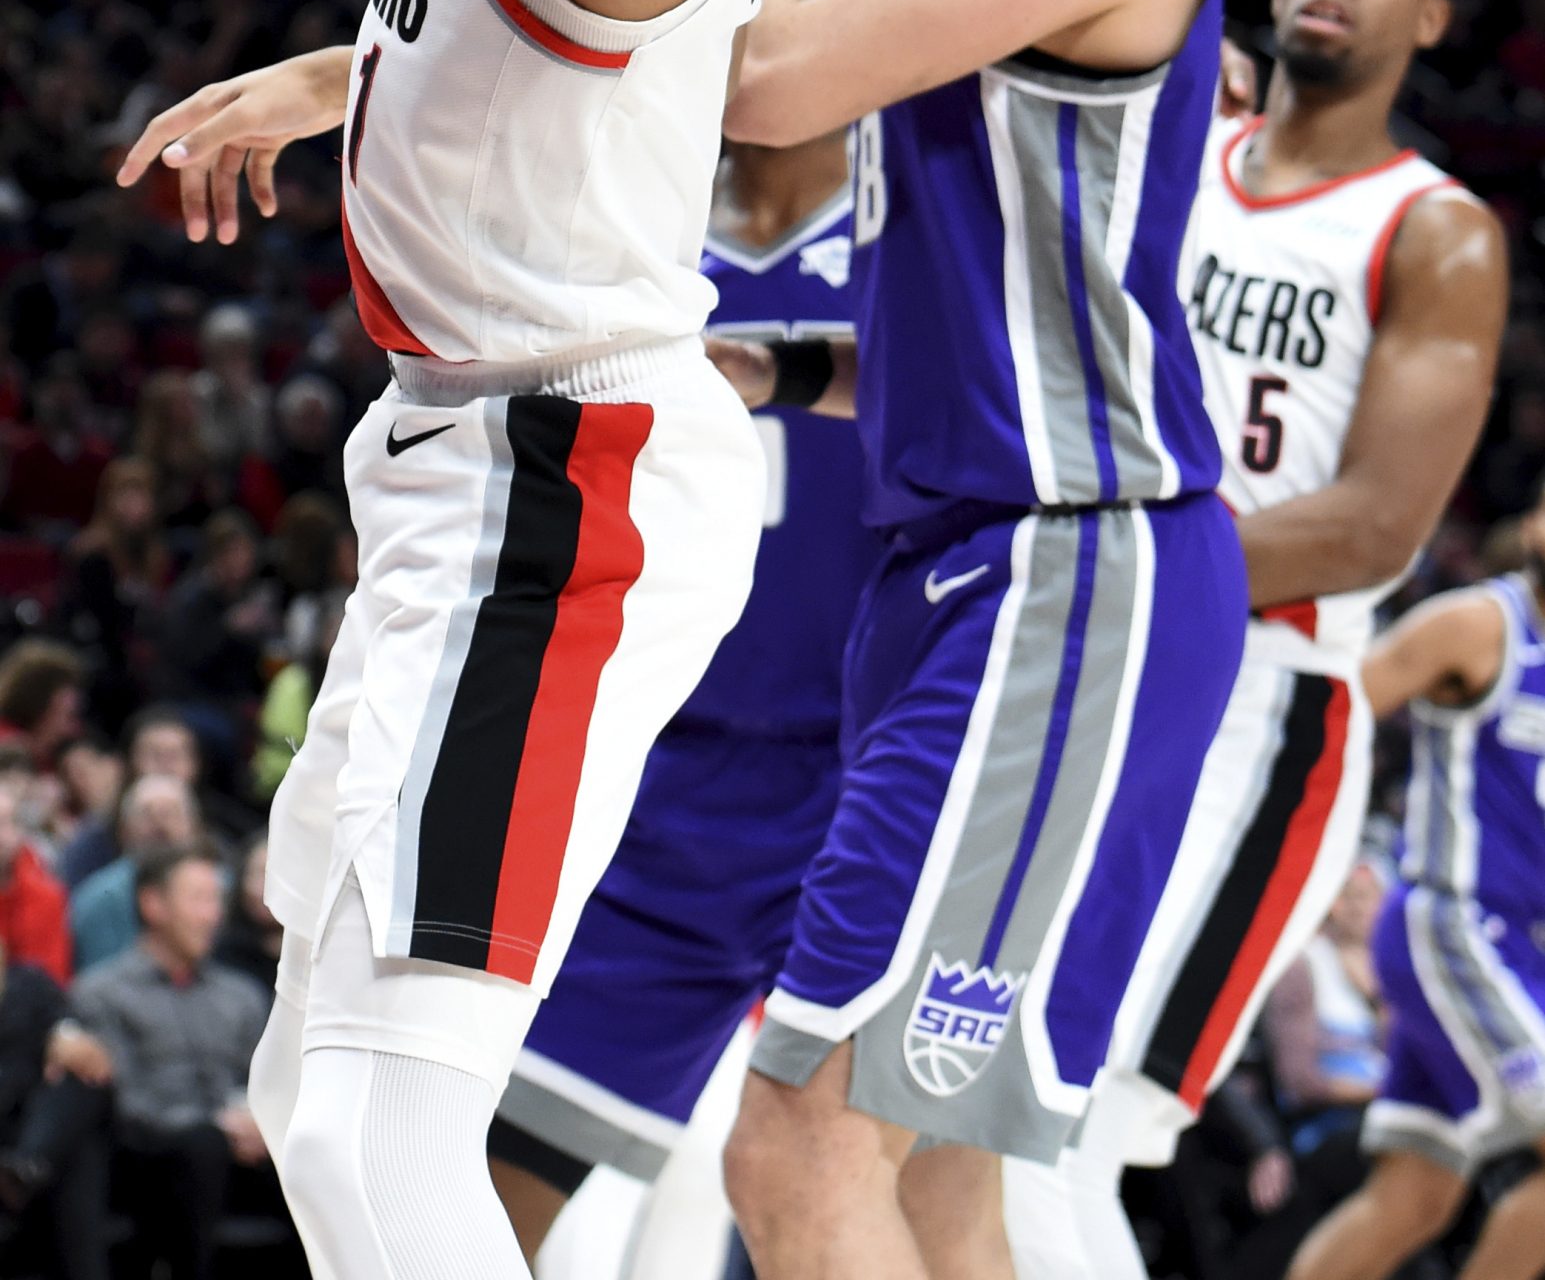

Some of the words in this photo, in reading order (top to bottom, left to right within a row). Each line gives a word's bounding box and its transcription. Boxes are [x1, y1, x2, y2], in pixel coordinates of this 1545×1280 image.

[349, 41, 382, 188] 1
[1242, 374, 1308, 474] 5
[912, 1004, 1004, 1046] SAC
